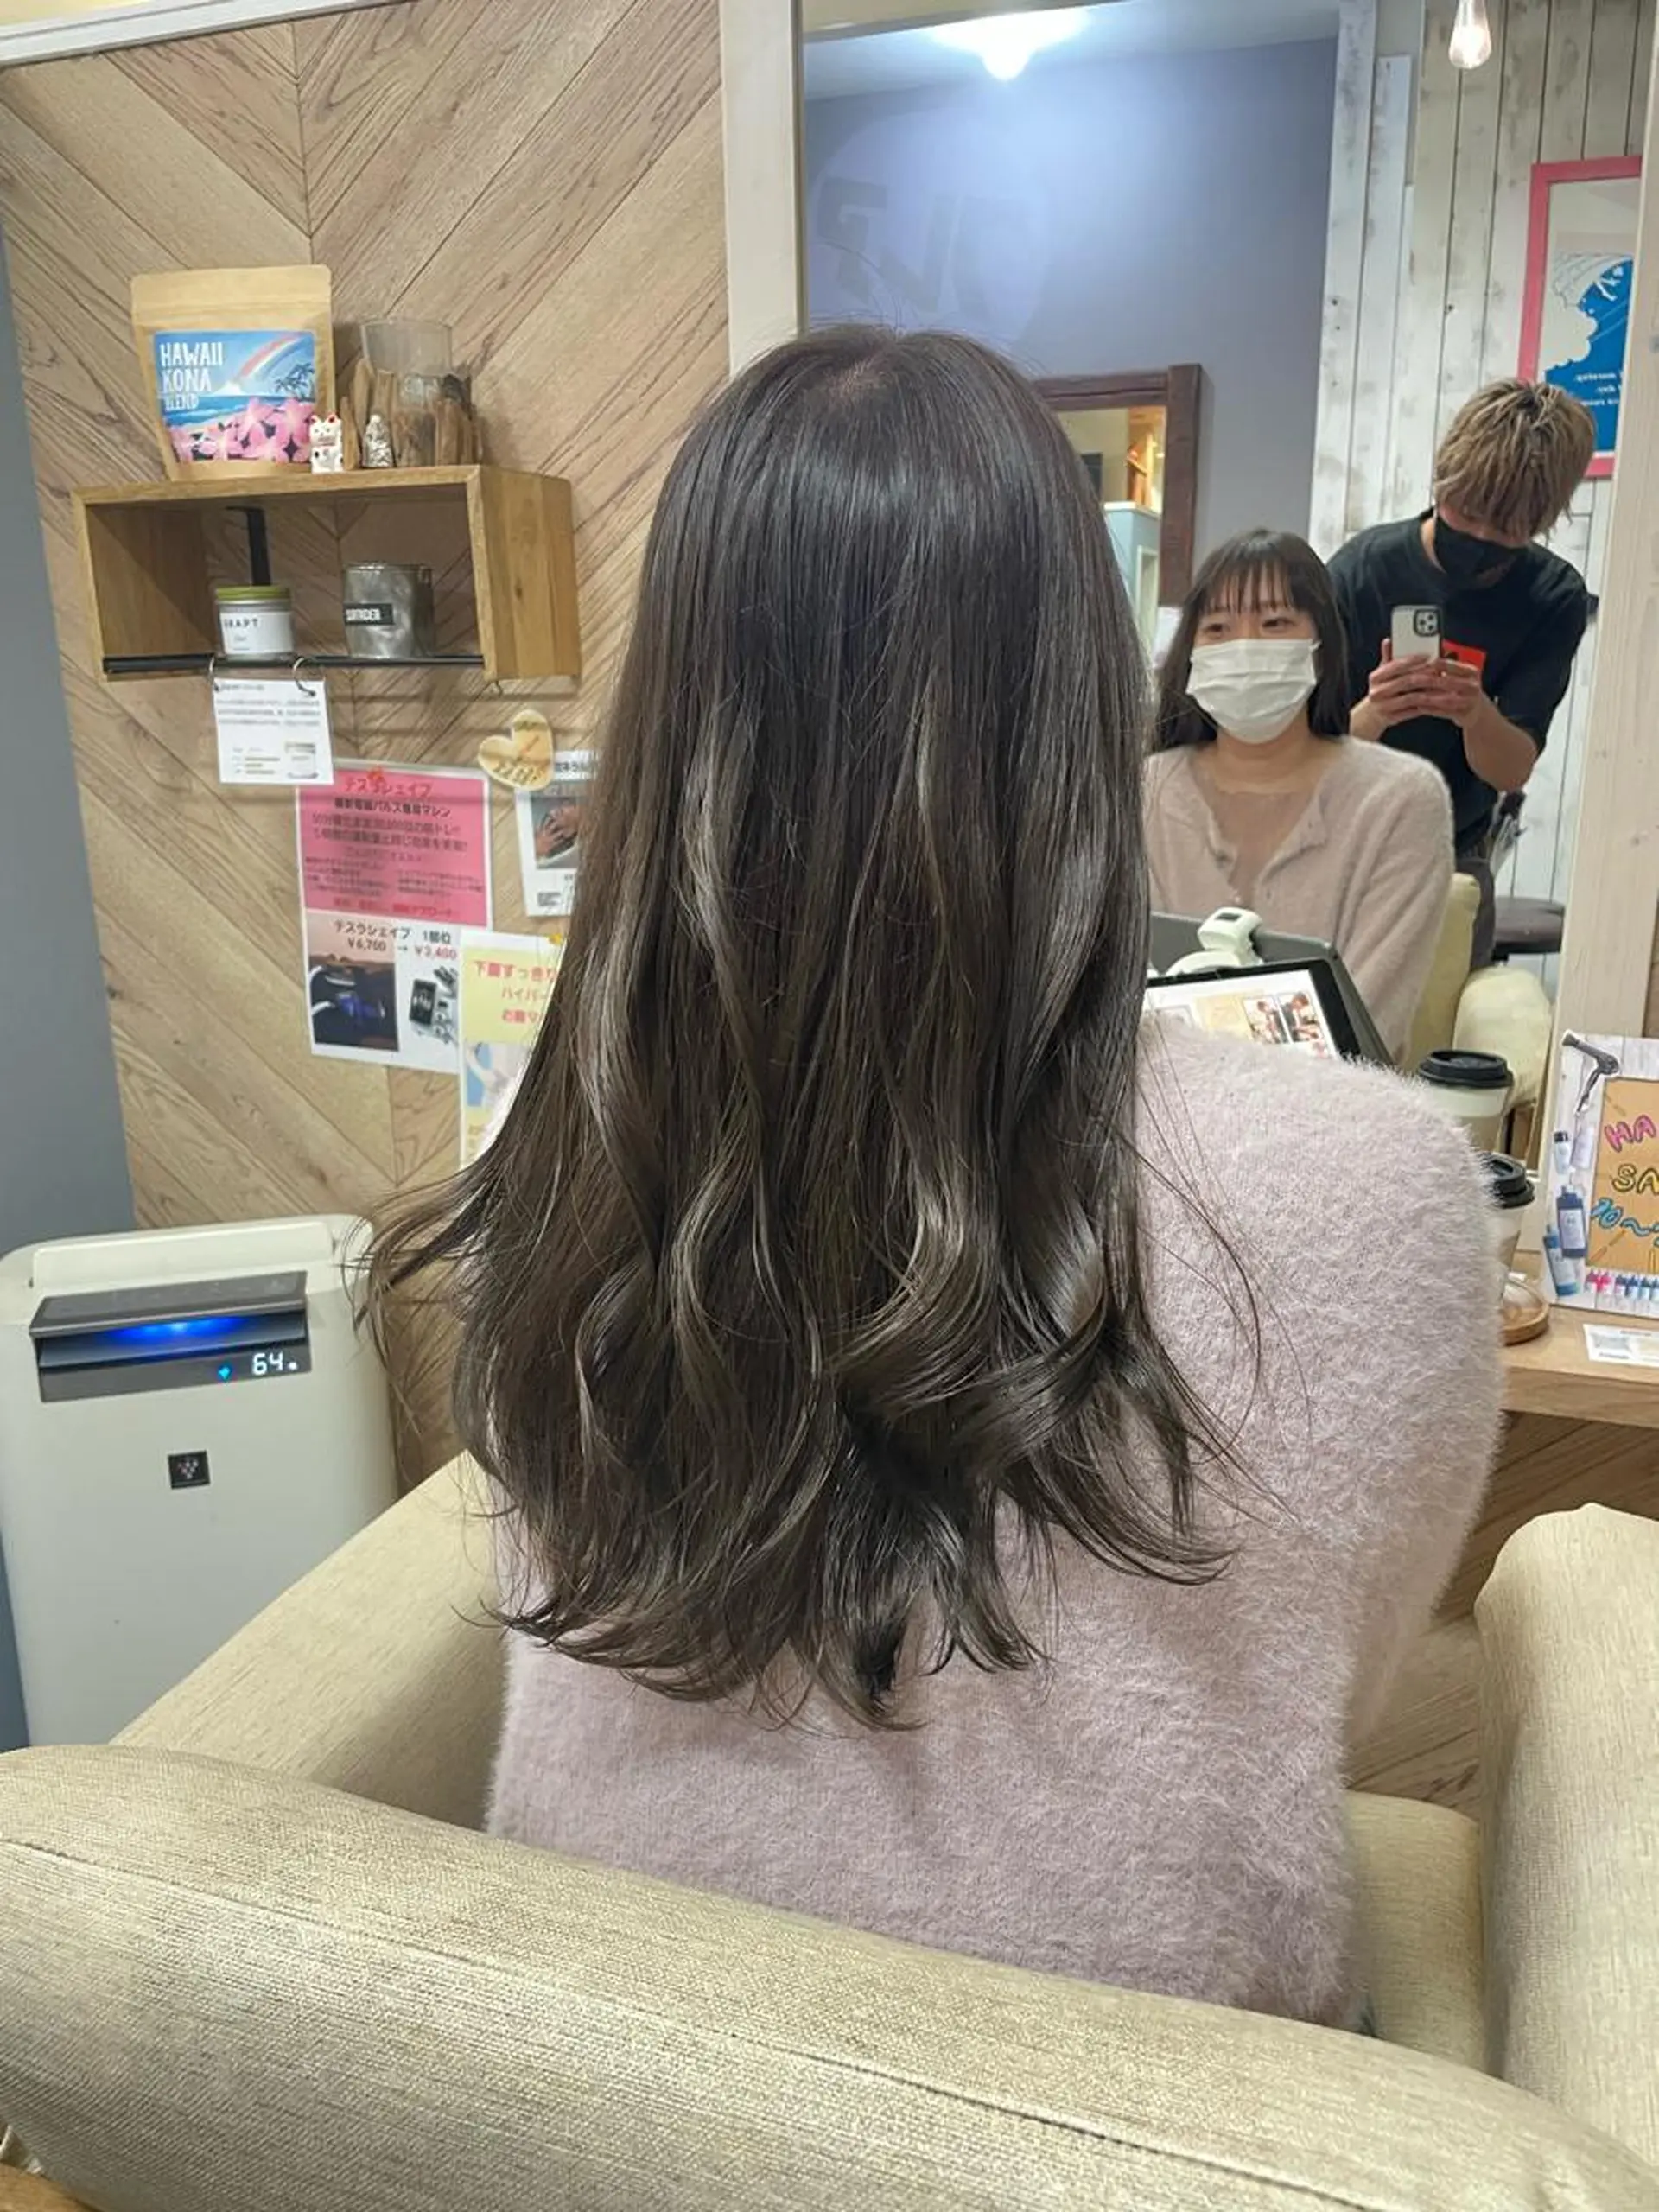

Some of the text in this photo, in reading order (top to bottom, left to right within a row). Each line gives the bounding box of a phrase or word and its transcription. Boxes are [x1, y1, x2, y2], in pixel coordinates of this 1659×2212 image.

[159, 341, 223, 367] HAWAII
[162, 368, 212, 394] KONA
[334, 919, 413, 940] テスラシェイプ
[252, 1351, 283, 1376] 64
